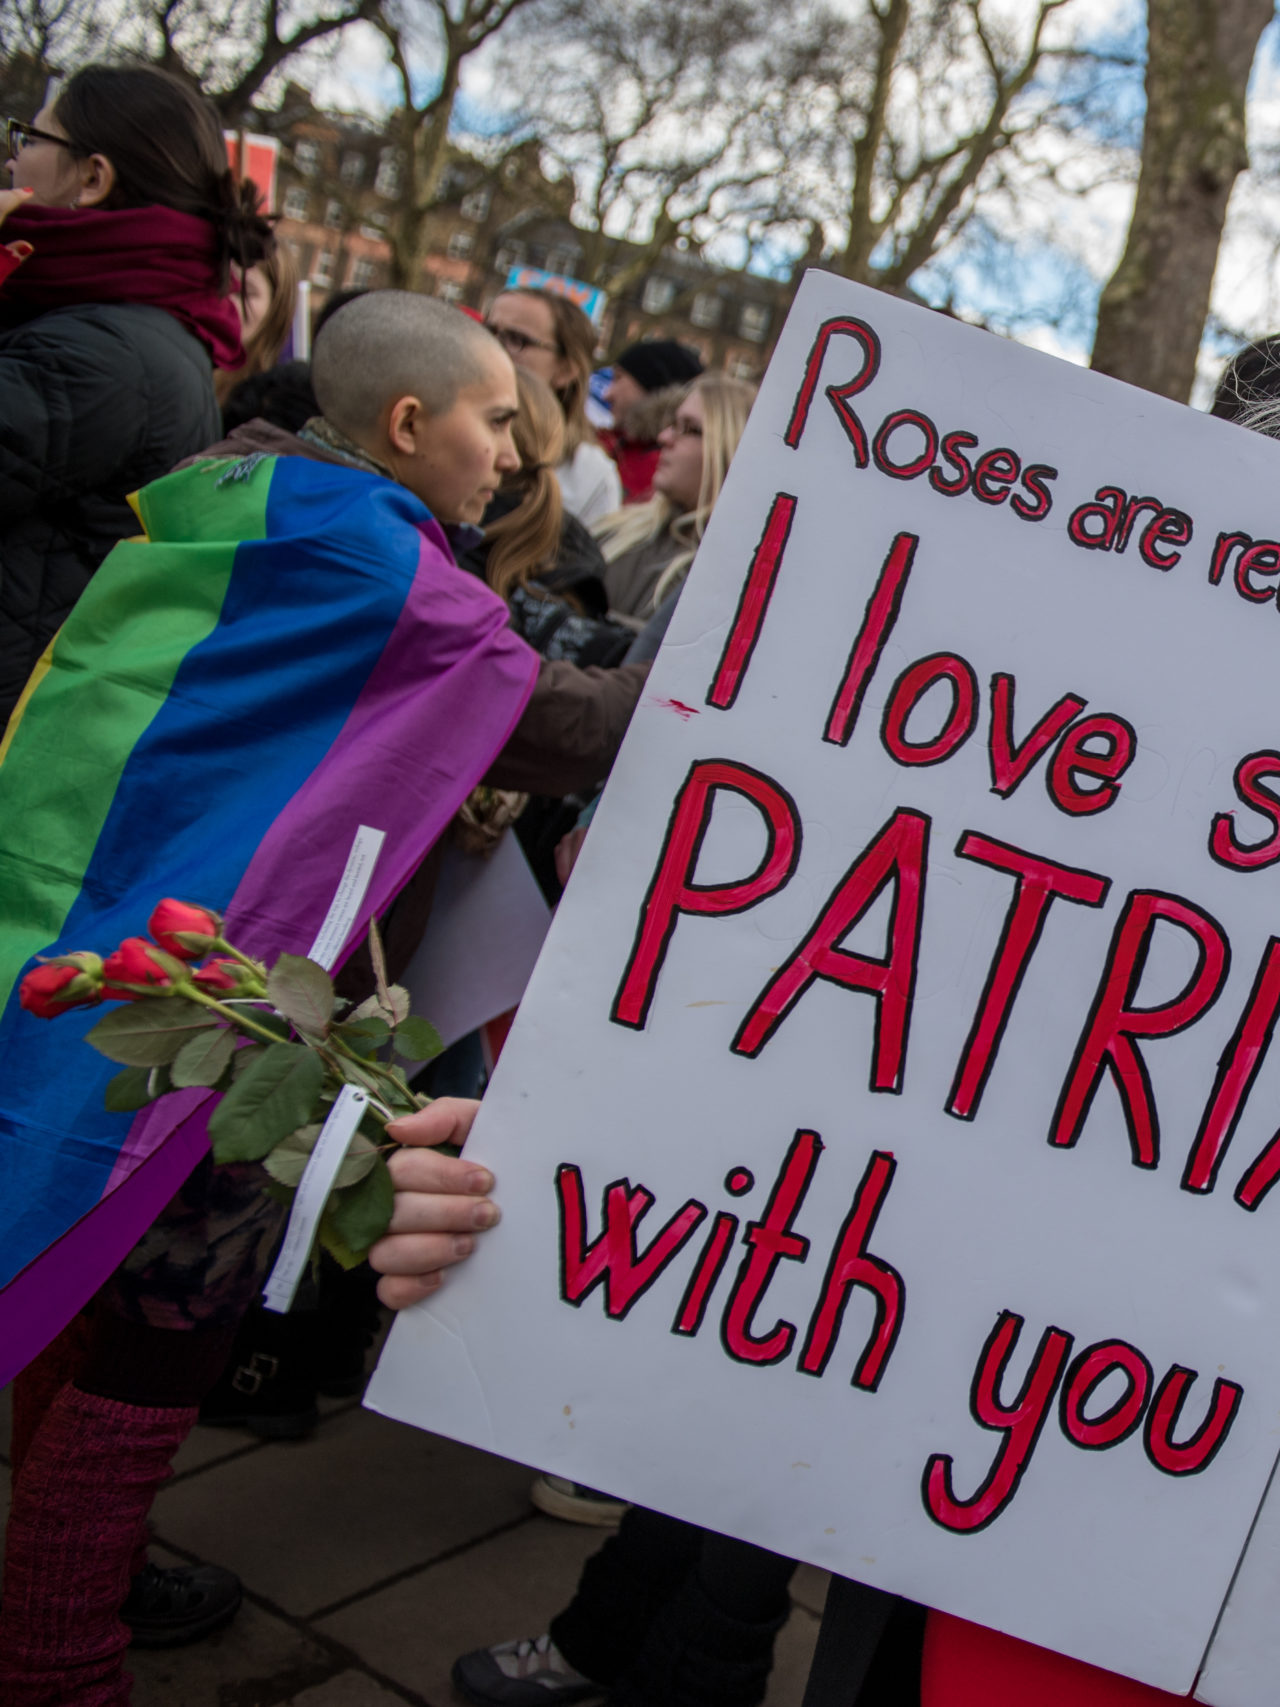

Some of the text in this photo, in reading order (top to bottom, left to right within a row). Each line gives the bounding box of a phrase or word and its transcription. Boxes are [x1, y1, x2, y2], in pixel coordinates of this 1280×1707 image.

[783, 314, 1059, 523] Roses
[1066, 485, 1194, 572] are
[704, 491, 799, 711] I
[821, 531, 1138, 818] love
[553, 1128, 907, 1394] with
[919, 1308, 1245, 1536] you
